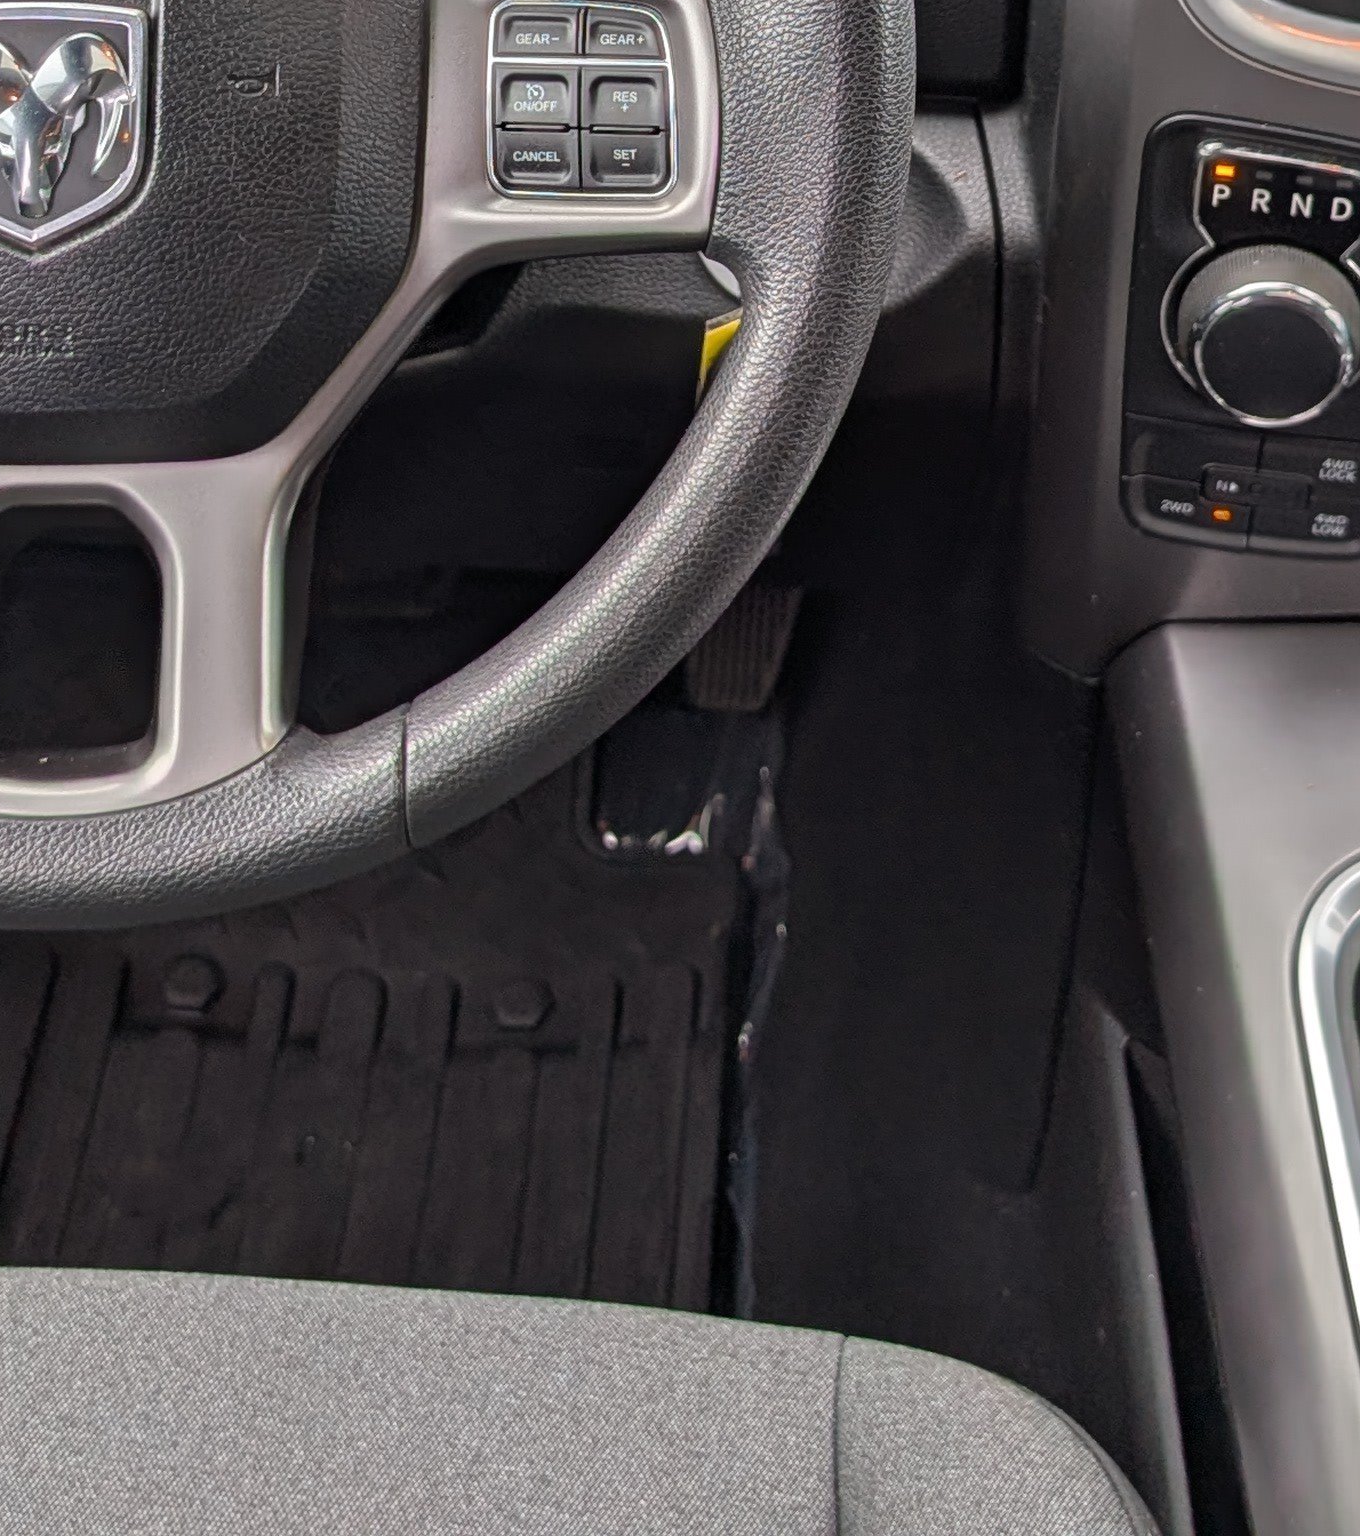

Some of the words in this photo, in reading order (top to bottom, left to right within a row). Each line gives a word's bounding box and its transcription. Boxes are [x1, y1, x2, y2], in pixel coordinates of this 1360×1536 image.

[612, 91, 638, 104] RES
[513, 100, 558, 113] ON/OFF
[512, 150, 561, 163] CANCEL
[613, 148, 638, 161] SET
[1211, 183, 1233, 208] P
[1250, 187, 1272, 215] R
[1289, 192, 1315, 220] N
[1329, 196, 1354, 222] D
